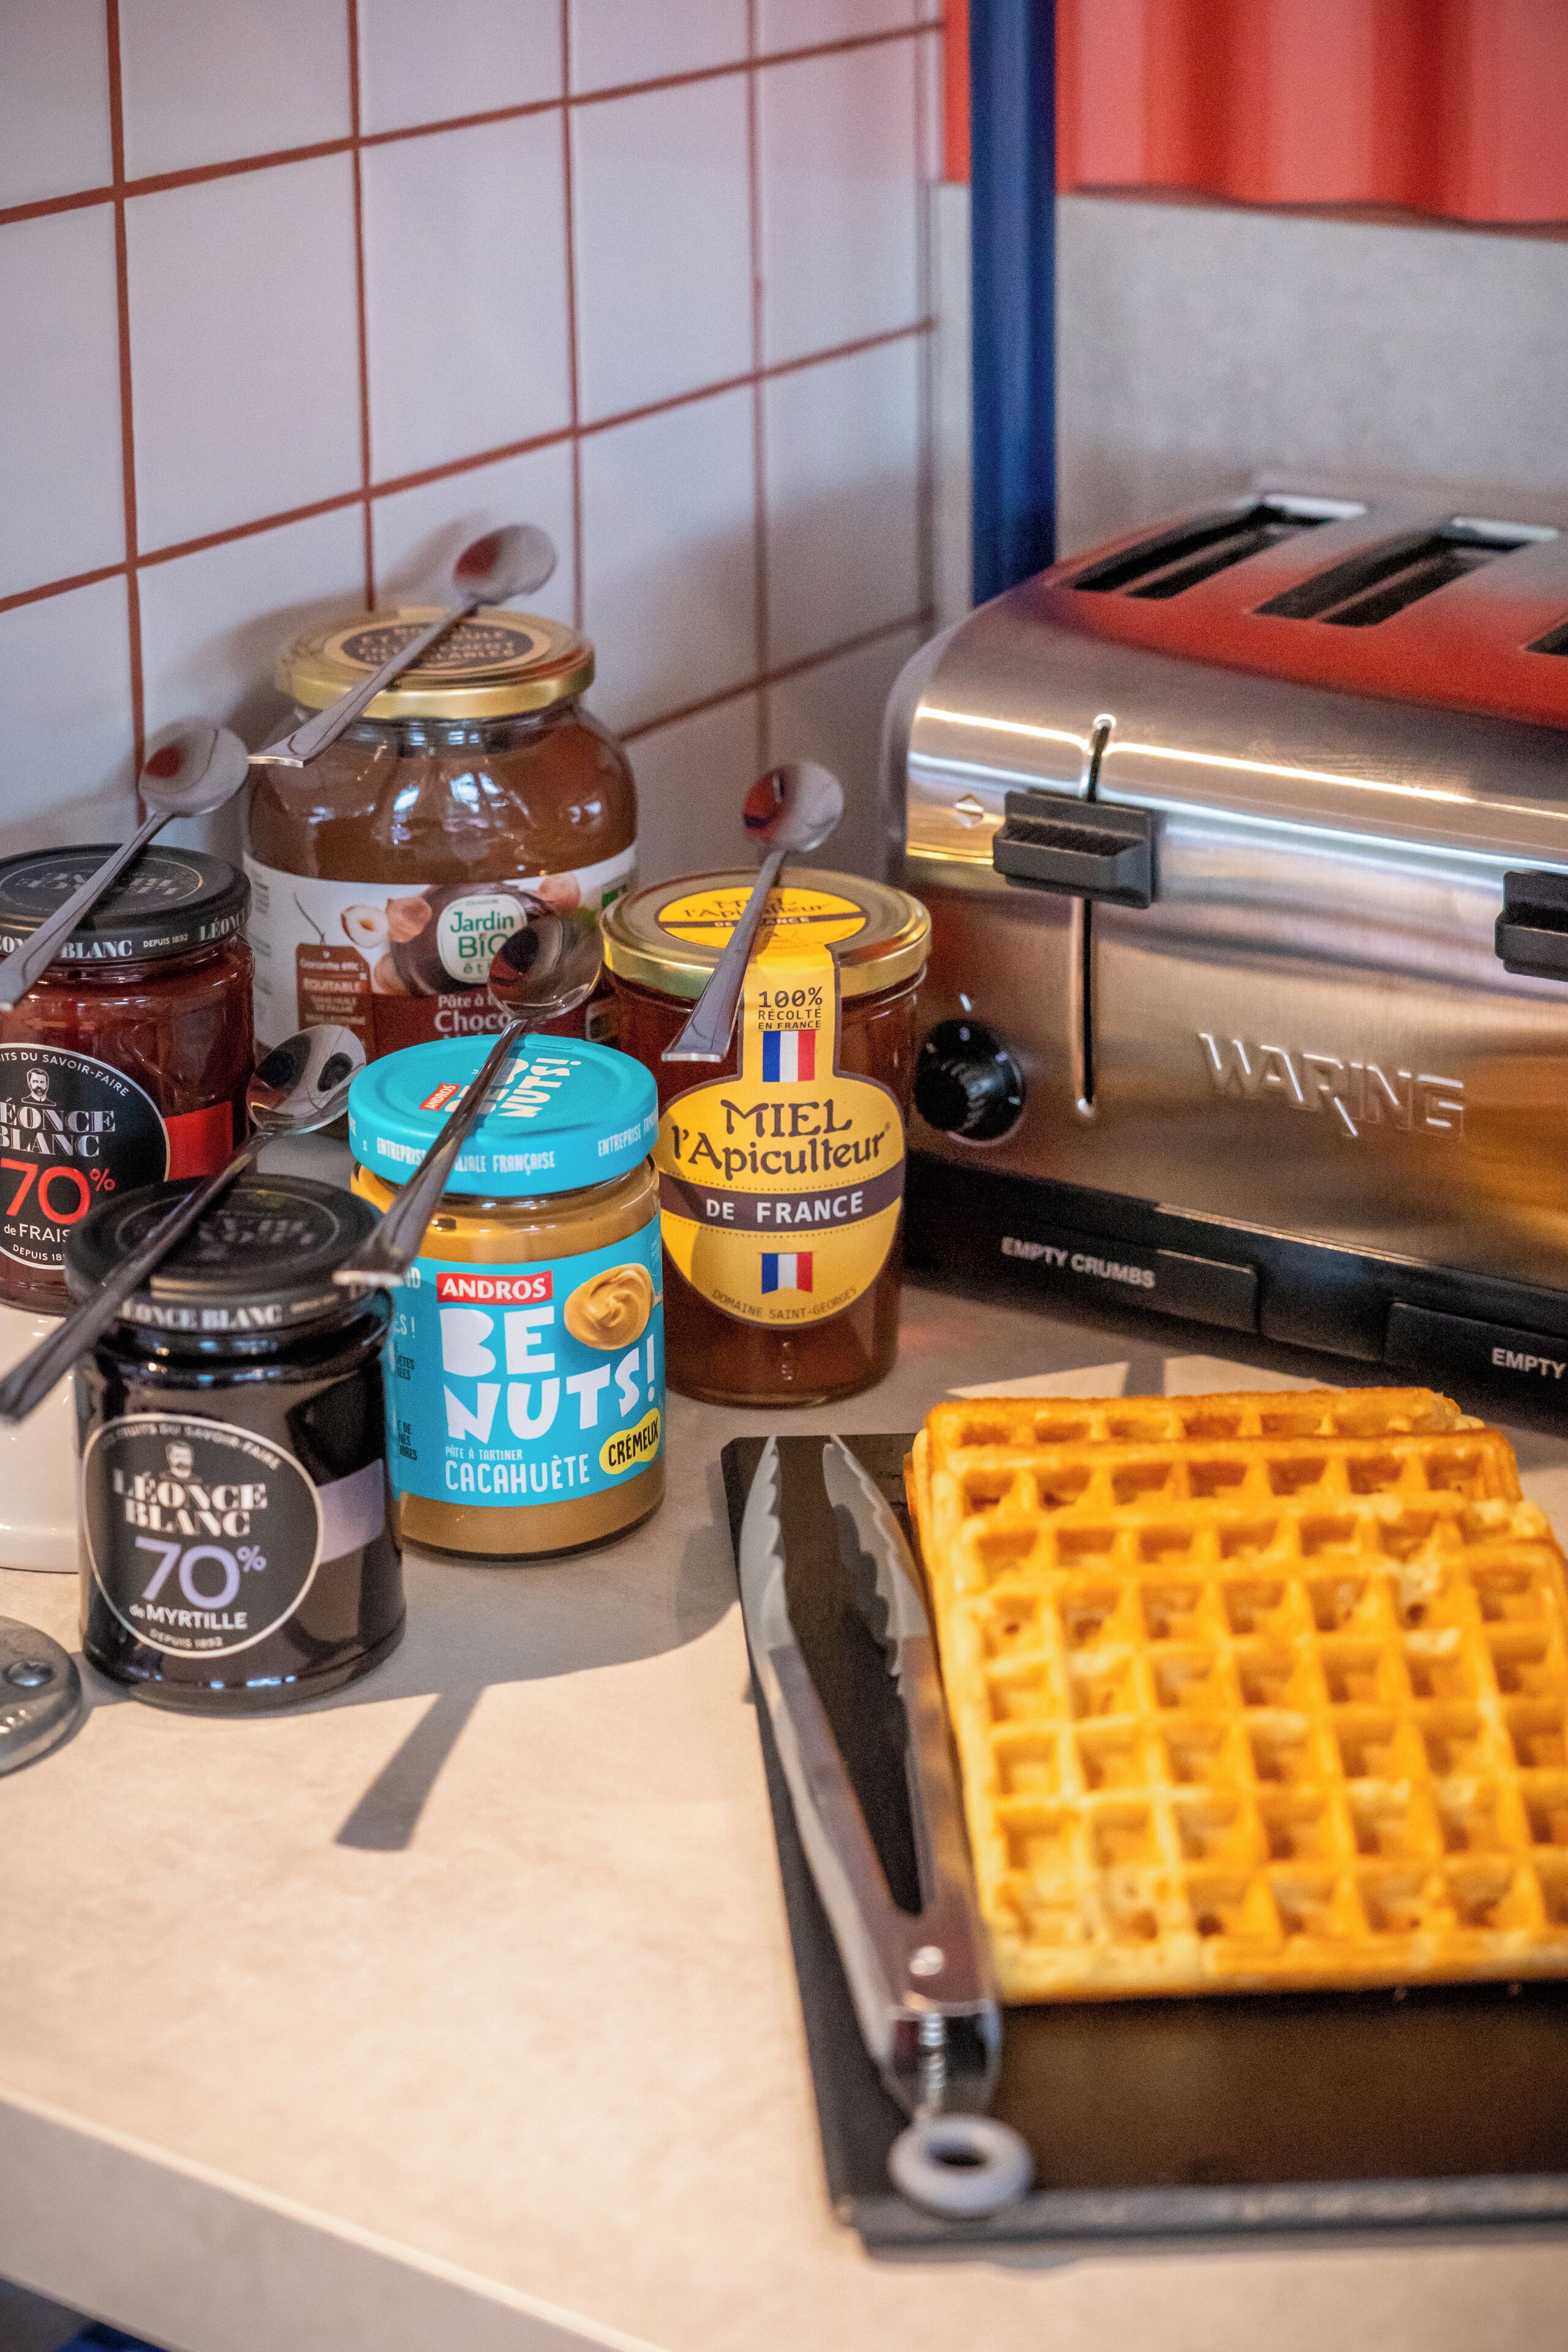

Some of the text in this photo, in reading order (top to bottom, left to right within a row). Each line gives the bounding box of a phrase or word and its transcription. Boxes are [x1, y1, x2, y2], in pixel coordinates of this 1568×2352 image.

[450, 911, 514, 932] Jardin
[61, 940, 132, 959] BLANC
[143, 937, 172, 948] DEPUIS
[758, 986, 823, 1009] 100%
[434, 1009, 512, 1033] Choco
[758, 1007, 822, 1021] RÉCOLTÉ
[758, 1020, 821, 1030] EN FRANCE
[21, 1052, 37, 1061] DU
[42, 1054, 129, 1096] SAVOIR-FAIRE
[497, 1058, 581, 1118] NUTS!
[1198, 1032, 1464, 1139] WARING
[425, 1084, 456, 1109] ANDROS
[0, 1097, 115, 1133] ÉONCE
[720, 1099, 853, 1138] MIEL
[493, 1151, 555, 1176] FRANÇAISE
[1, 1158, 115, 1224] 70%
[706, 1191, 864, 1224] DE FRANCE
[4, 1223, 71, 1243] de FRAIS
[12, 1243, 64, 1262] DEPUIS 18
[1001, 1236, 1156, 1289] EMPTY CRUMBS
[441, 1277, 546, 1300] ANDROS
[712, 1287, 858, 1320] DOMAINE SAINT-GEORGES
[121, 1297, 282, 1329] ÉONCE BLANC
[439, 1306, 556, 1377] BE
[1491, 1348, 1566, 1379] EMPTY
[443, 1334, 655, 1444] NUTS!
[445, 1445, 522, 1461] PÂTE À TARTINER
[608, 1417, 659, 1468] CRÉMEUX
[114, 1468, 268, 1511] LÉONCE
[445, 1453, 590, 1494] CACAHUÈTE
[126, 1498, 251, 1537] BLANC
[135, 1536, 266, 1609] 70%
[146, 1604, 247, 1630] MYRTILLE
